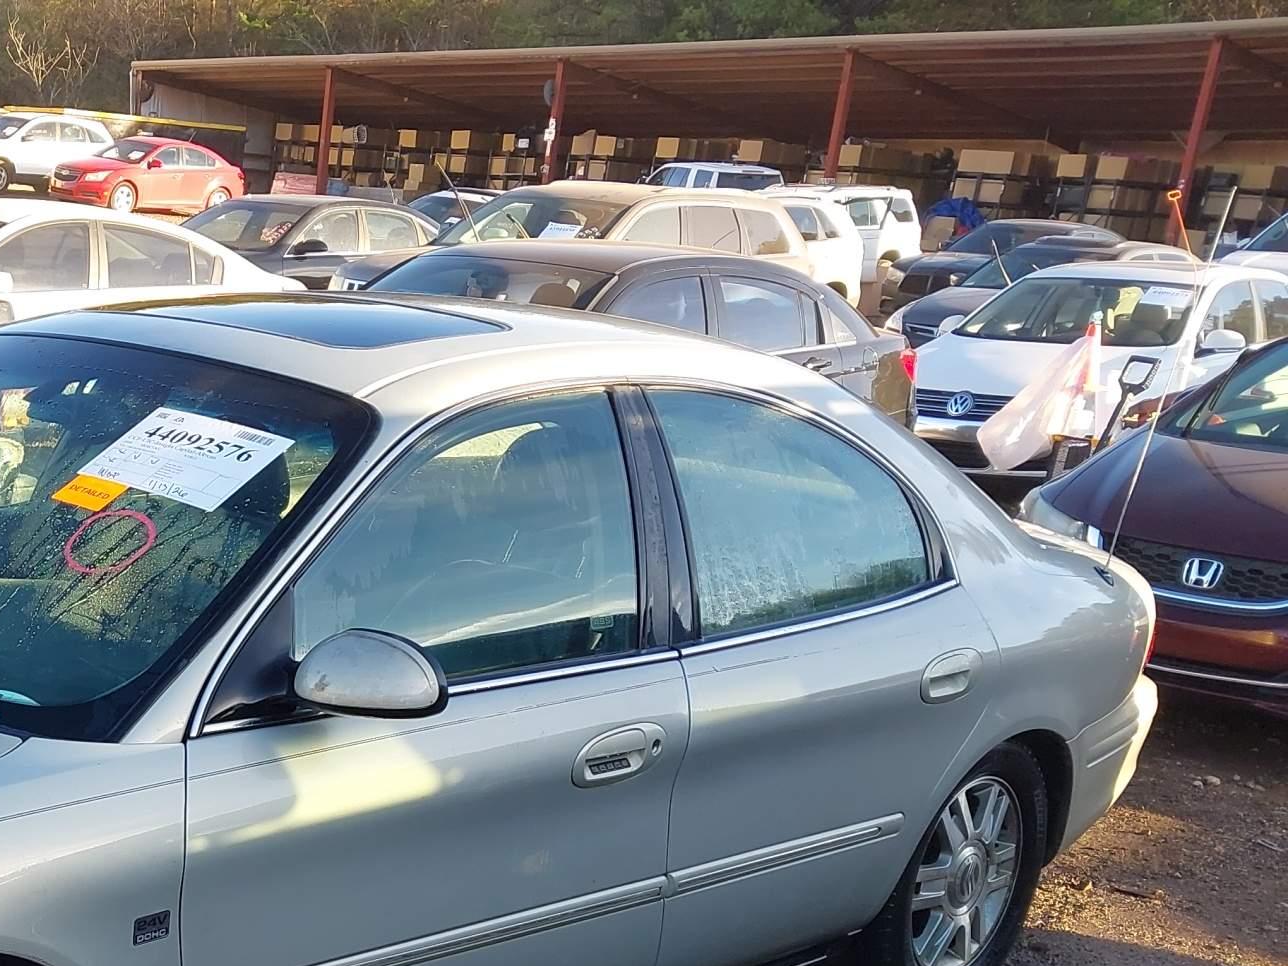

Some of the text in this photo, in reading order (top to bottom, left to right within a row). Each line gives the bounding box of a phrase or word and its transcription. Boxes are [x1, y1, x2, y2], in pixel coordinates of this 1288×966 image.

[145, 426, 259, 462] 44092576
[69, 484, 110, 499] DETAILED
[137, 913, 168, 931] 24V
[136, 928, 167, 943] DOHC
